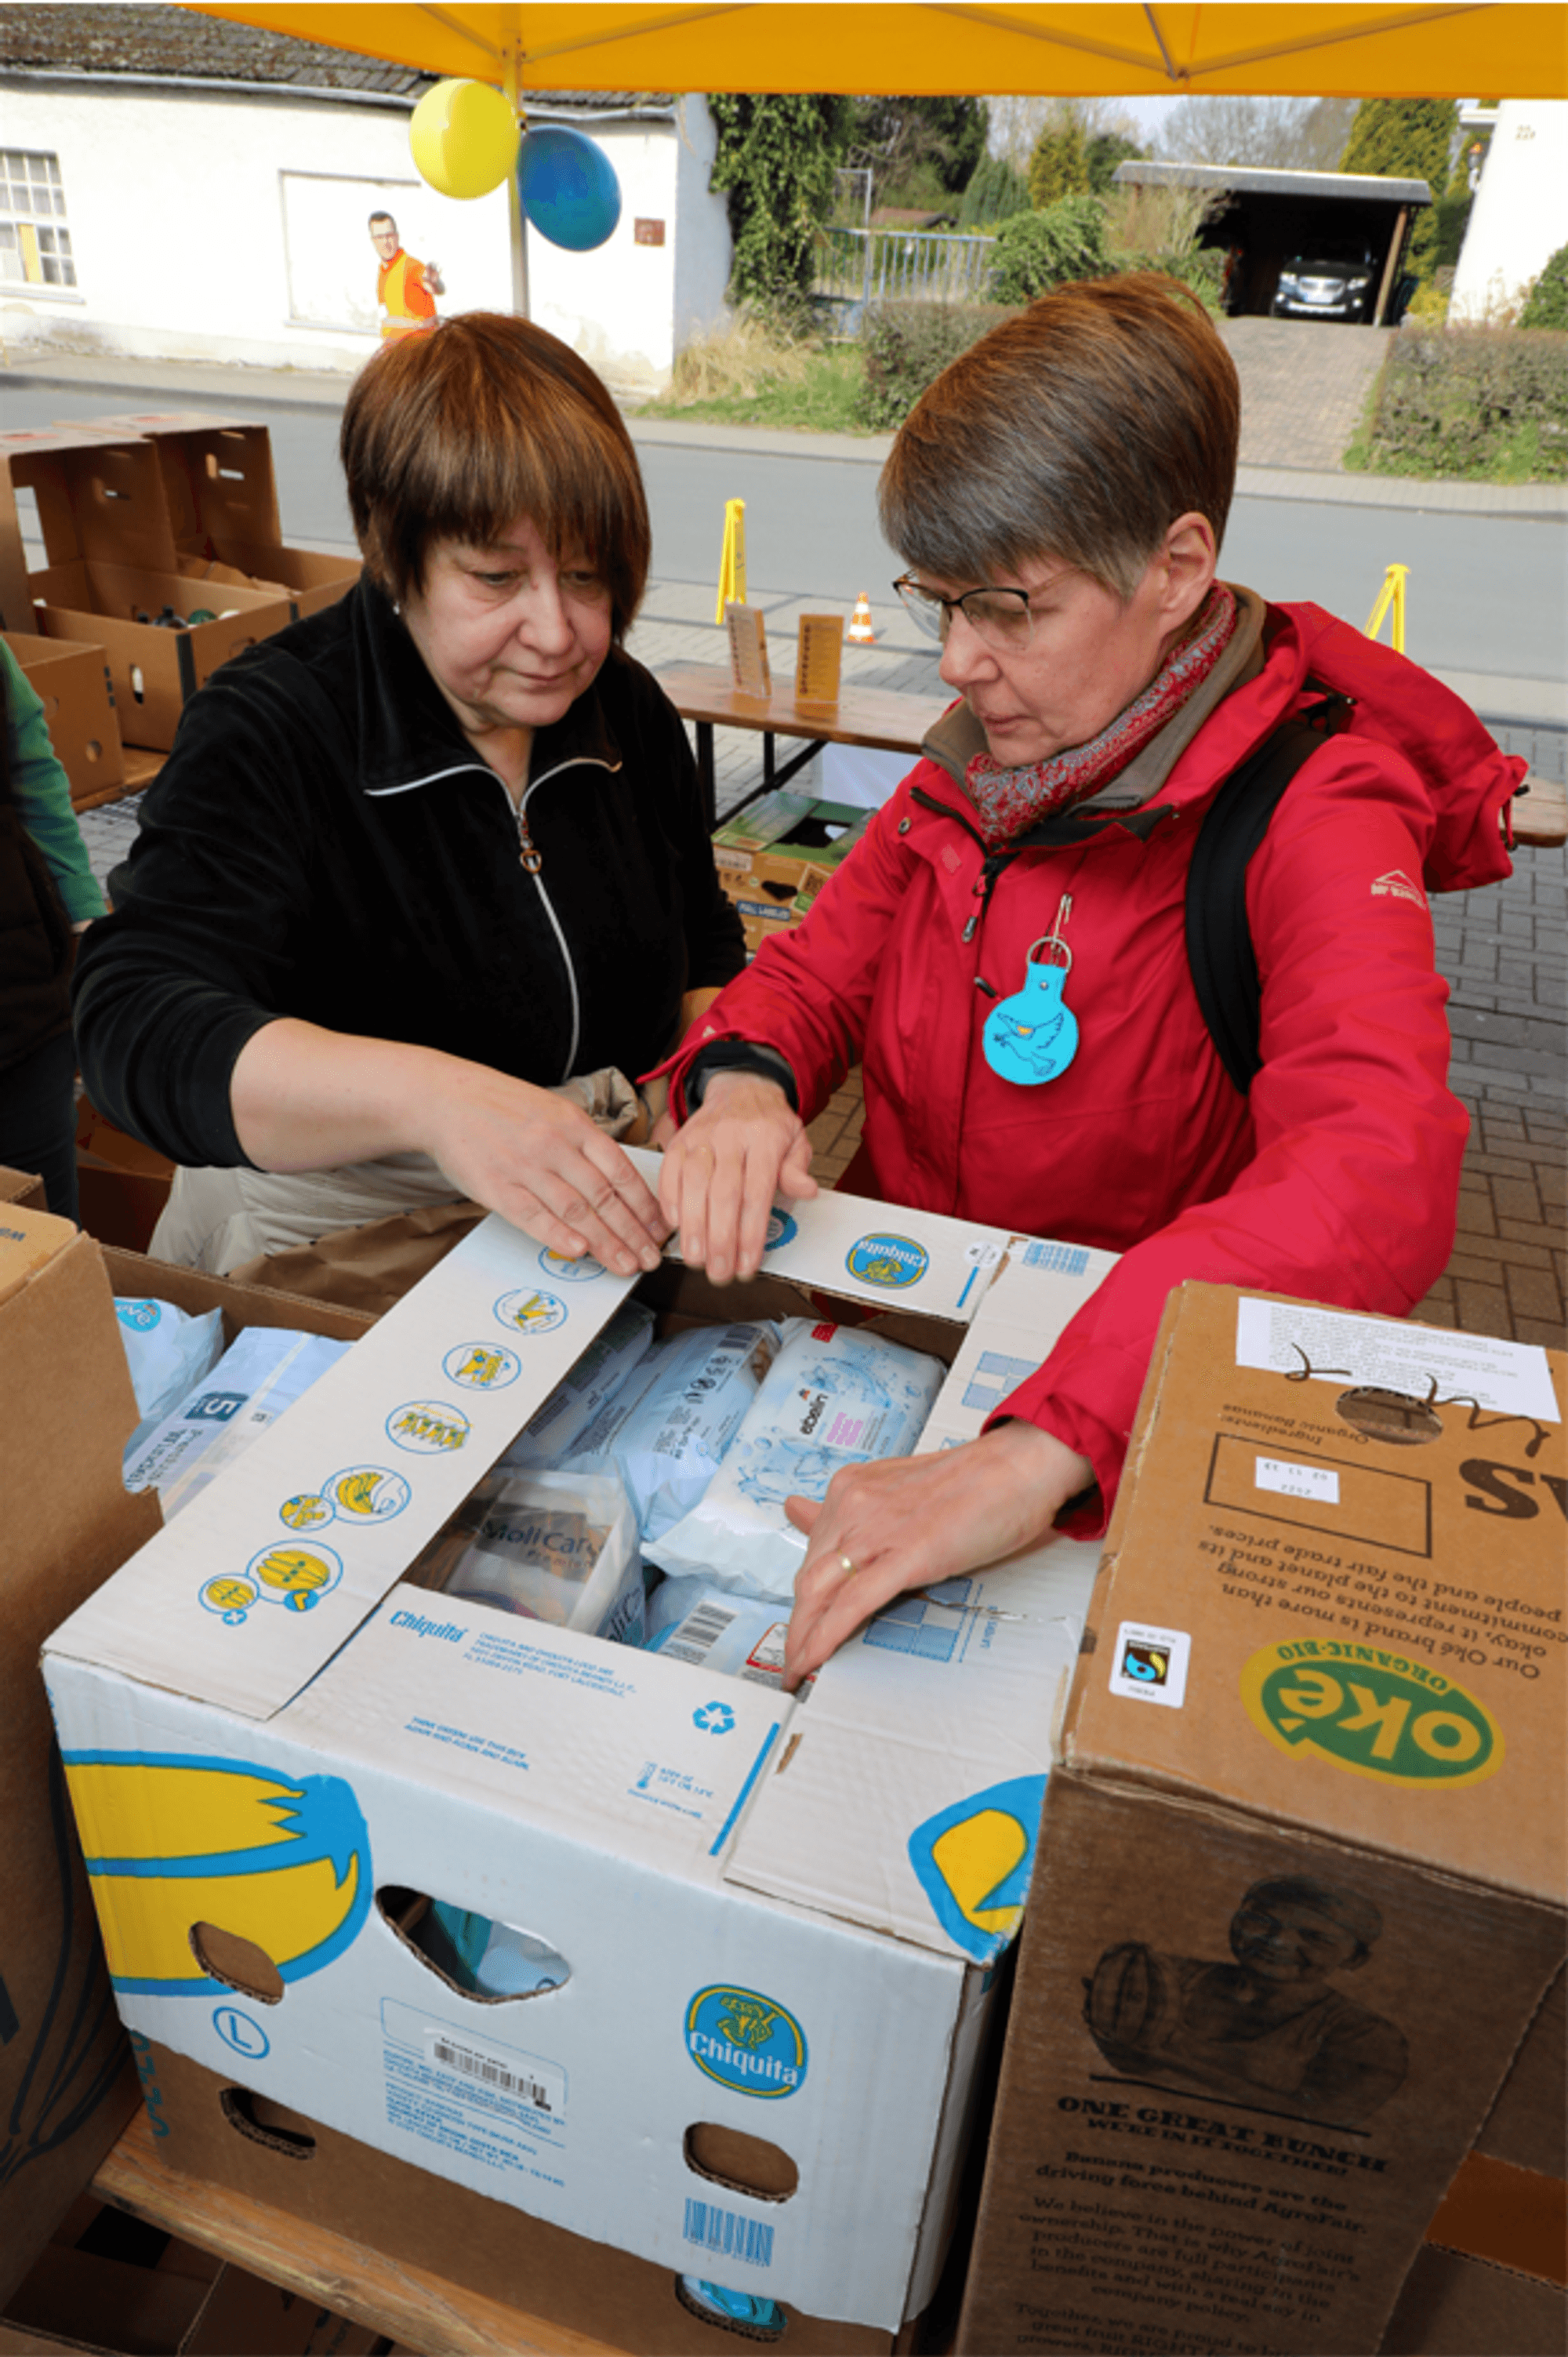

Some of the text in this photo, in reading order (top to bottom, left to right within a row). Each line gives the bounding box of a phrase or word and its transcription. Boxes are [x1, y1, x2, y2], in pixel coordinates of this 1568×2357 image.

[800, 1393, 829, 1435] ebelin
[1221, 1403, 1296, 1428] Bananas
[1197, 1539, 1568, 1643] commitment to the planet and its
[1208, 1524, 1563, 1622] people and the fair trade prices.
[390, 1610, 468, 1643] Chiquita
[1216, 1560, 1547, 1659] okay, it represents our strong
[1221, 1582, 1541, 1680] Our Oké brand is more than
[229, 2014, 252, 2050] L
[689, 2031, 798, 2086] Chiquita
[1055, 2095, 1388, 2173] ONE GREAT BUNCH
[1161, 2129, 1186, 2143] IN
[1190, 2134, 1216, 2148] IT
[1034, 2165, 1115, 2187] driving
[1119, 2174, 1176, 2194] force
[1179, 2184, 1258, 2209] behind
[1064, 2150, 1347, 2211] Banana producers are the
[1033, 2195, 1064, 2210] We
[1069, 2199, 1144, 2221] believe
[1146, 2213, 1167, 2226] in
[1172, 2217, 1206, 2232] the
[1210, 2227, 1274, 2246] power
[1131, 2225, 1178, 2244] That
[1207, 2241, 1248, 2258] why
[1031, 2229, 1132, 2251] producers
[1137, 2245, 1168, 2259] are
[1174, 2247, 1209, 2265] full
[1112, 2272, 1151, 2287] and
